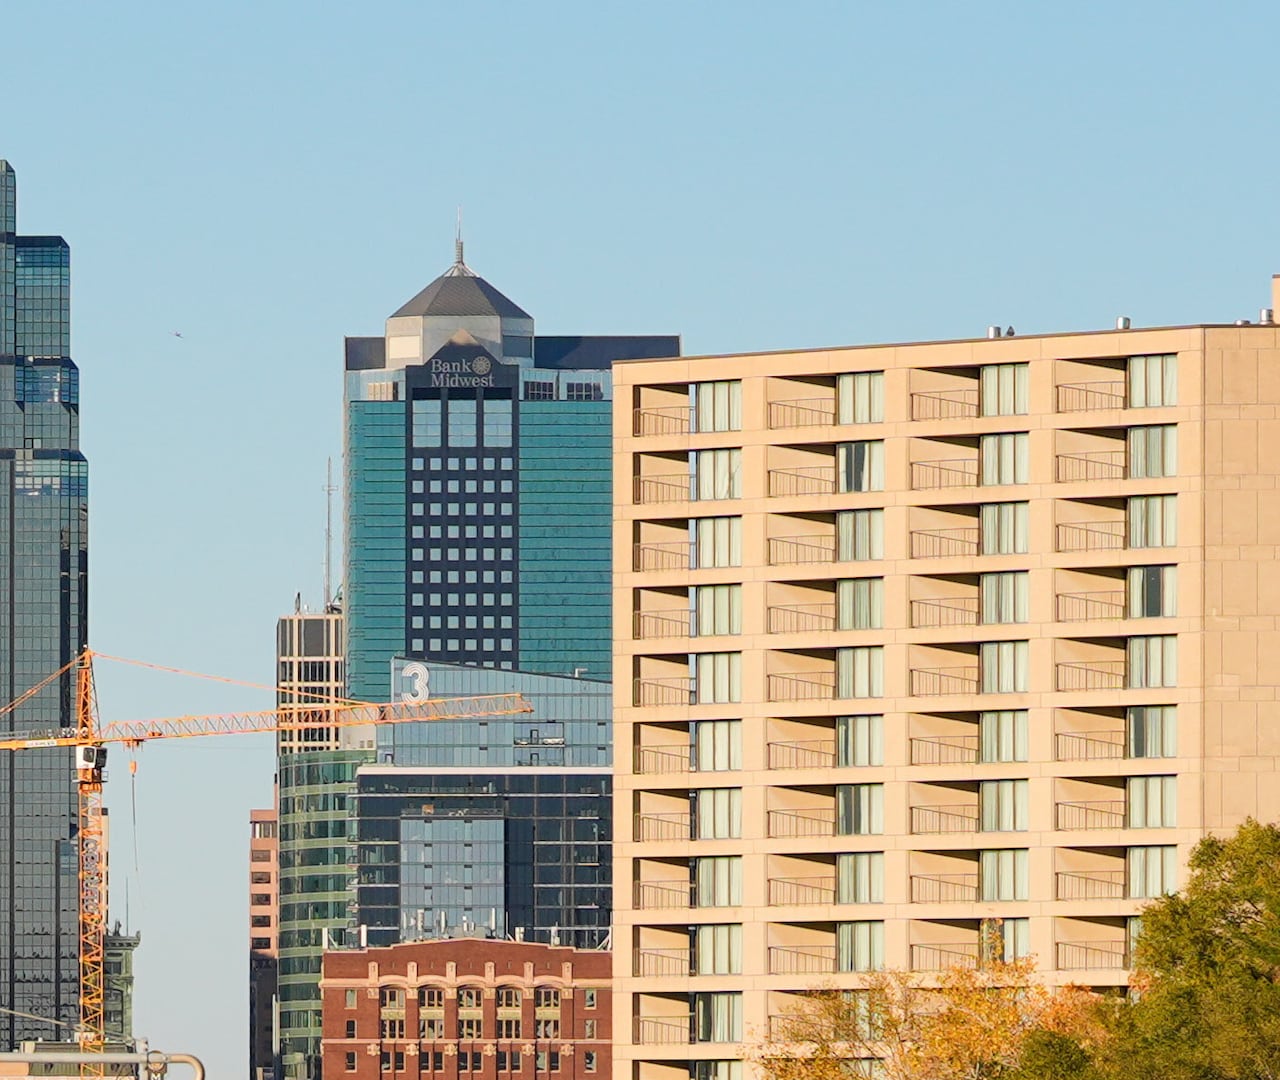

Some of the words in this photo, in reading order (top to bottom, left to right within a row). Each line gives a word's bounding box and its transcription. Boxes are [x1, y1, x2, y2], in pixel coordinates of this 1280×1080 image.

[432, 359, 472, 373] Bank
[431, 373, 495, 388] Midwest
[401, 662, 429, 705] 3
